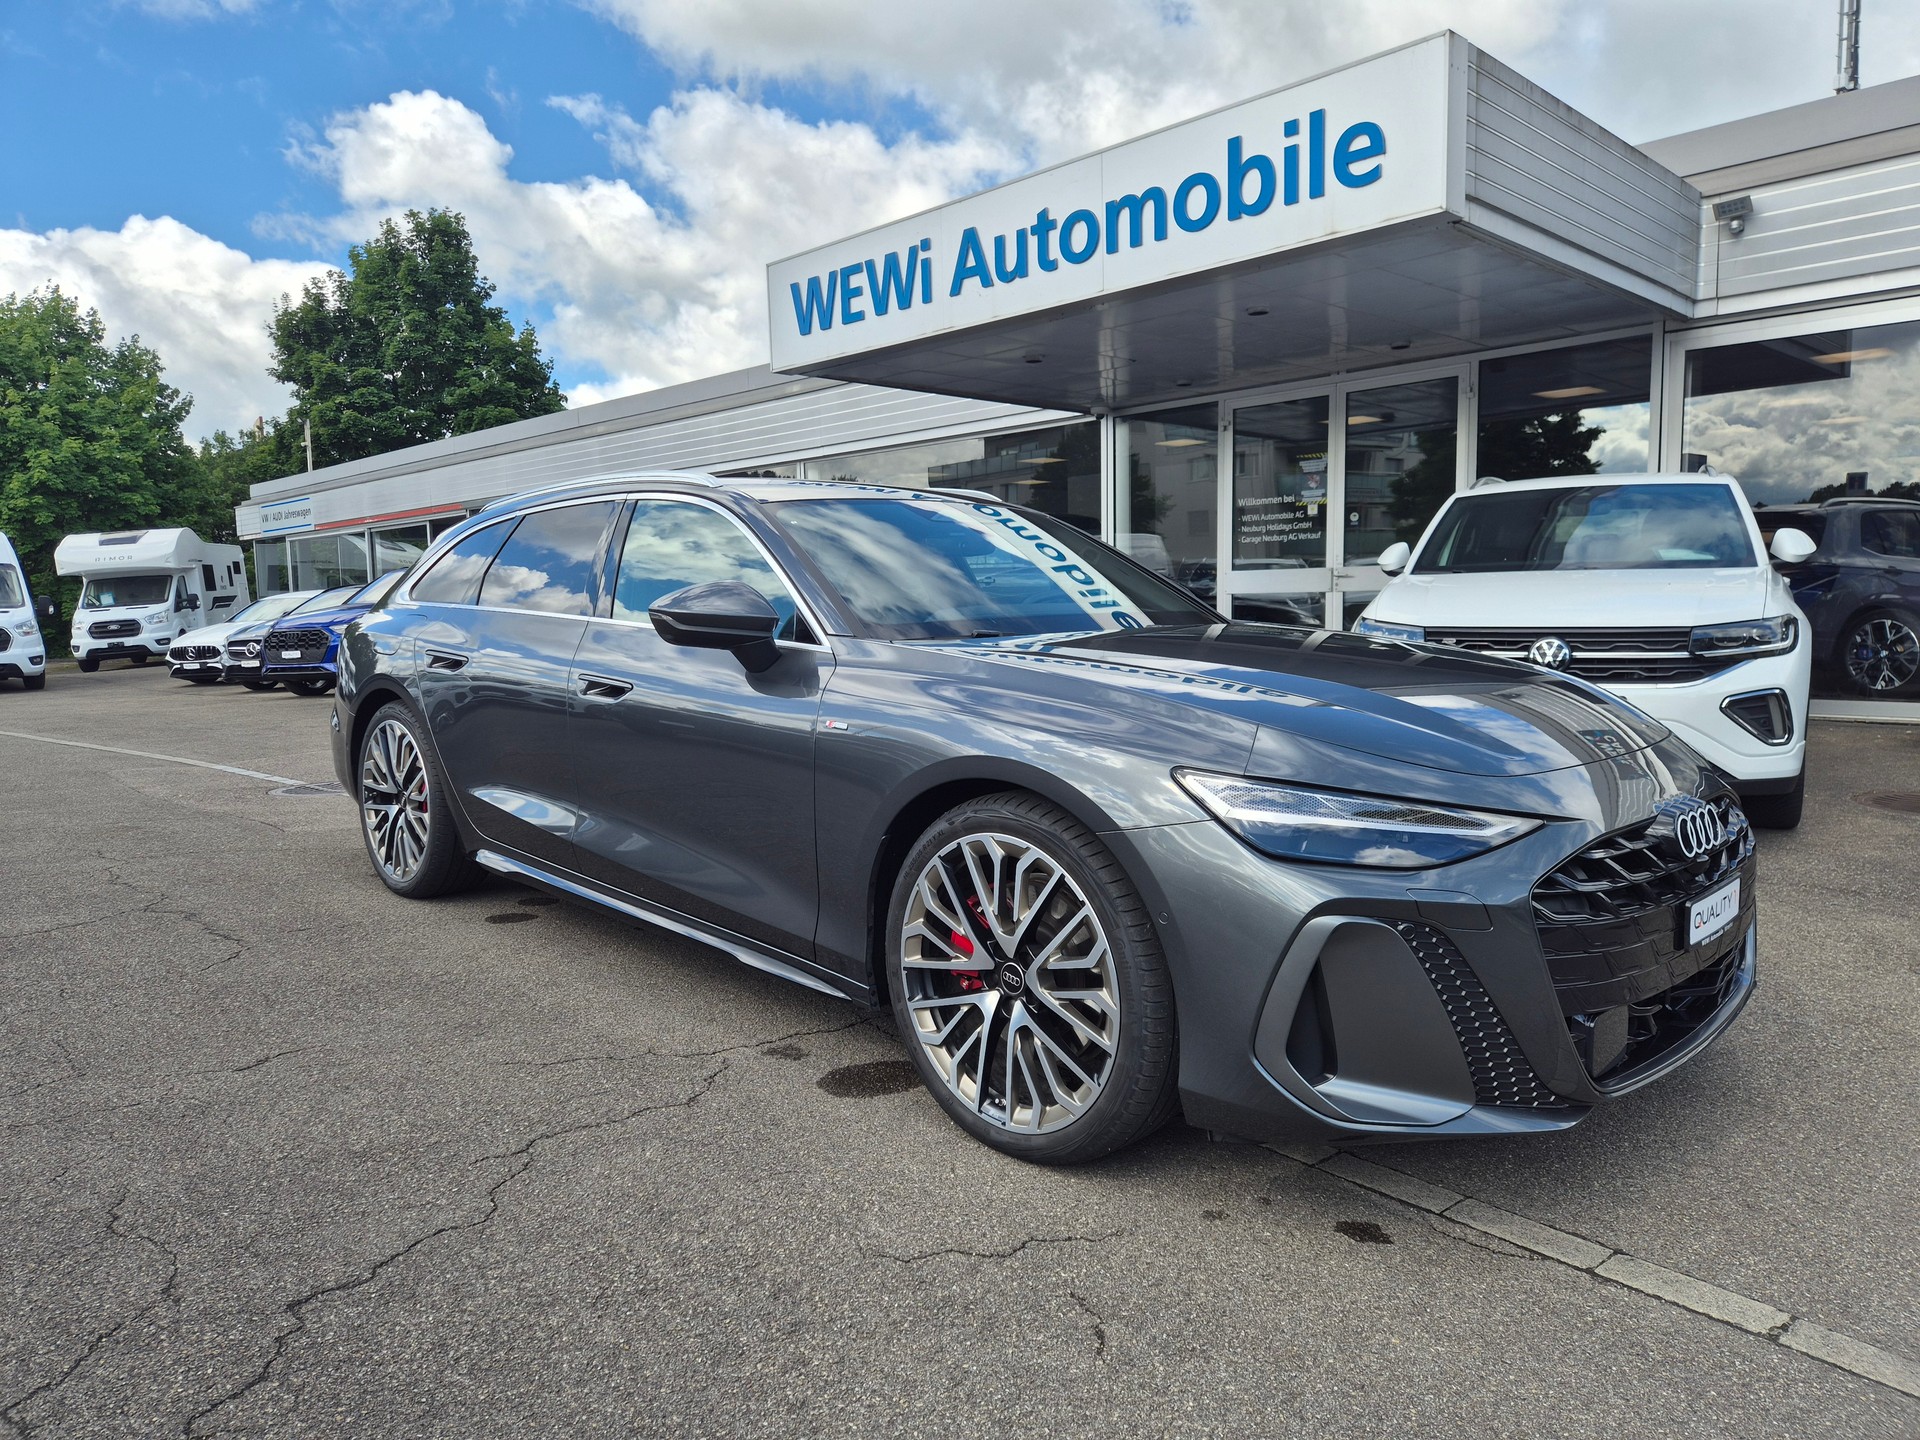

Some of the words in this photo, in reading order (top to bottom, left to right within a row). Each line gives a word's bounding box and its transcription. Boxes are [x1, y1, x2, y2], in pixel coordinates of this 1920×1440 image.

[790, 237, 932, 336] WEWi
[949, 108, 1386, 297] Automobile
[1238, 497, 1282, 506] Willkommen
[1283, 494, 1295, 503] bei
[261, 514, 269, 523] VW
[272, 511, 283, 521] AUDI
[283, 508, 311, 520] Jahreswagen
[1241, 514, 1260, 522] WEWi
[1260, 512, 1294, 521] Automobile
[1295, 511, 1304, 519] AG
[1241, 525, 1266, 533] Neuburg
[1267, 523, 1292, 531] Holidays
[1293, 521, 1312, 529] GmbH
[1241, 536, 1263, 544] Garage
[1263, 534, 1287, 542] Neuburg
[1298, 531, 1322, 540] Verkauf
